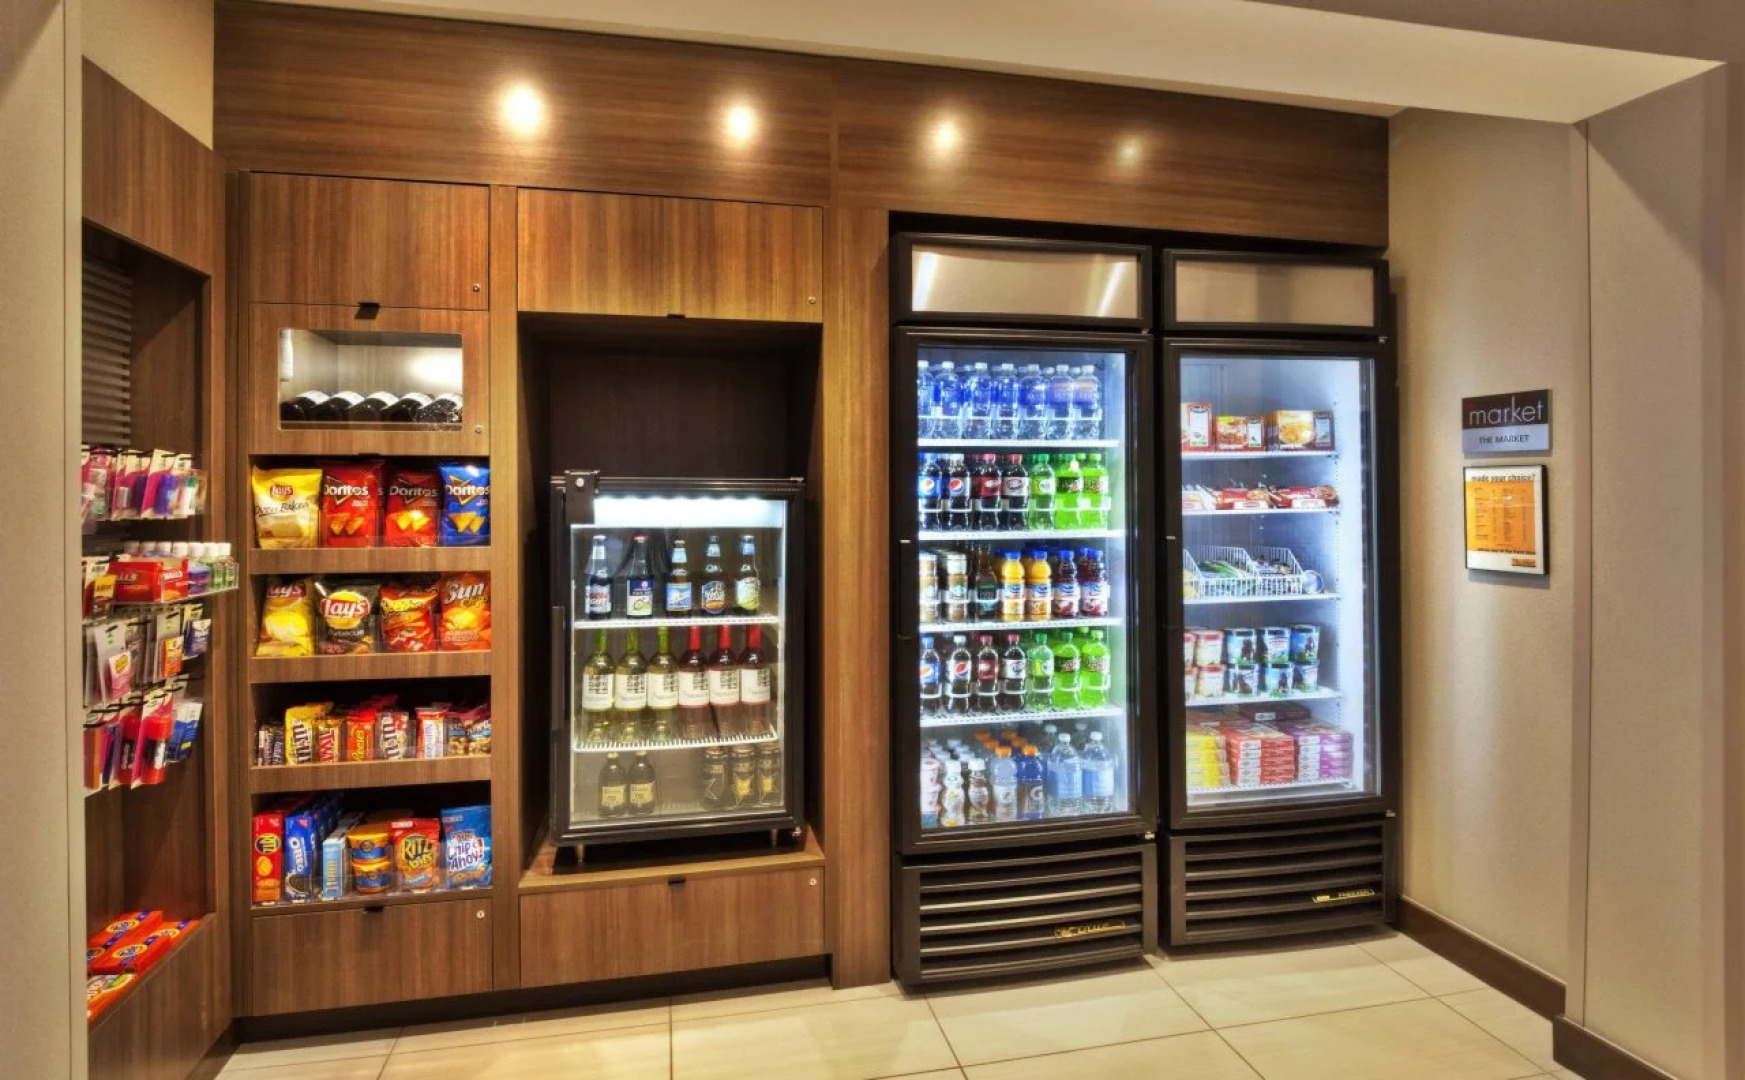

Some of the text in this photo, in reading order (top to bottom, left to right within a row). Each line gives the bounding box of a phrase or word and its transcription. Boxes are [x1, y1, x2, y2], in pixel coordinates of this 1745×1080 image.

[1469, 395, 1543, 425] market
[1478, 434, 1530, 444] THE MARKET
[1491, 475, 1506, 483] your
[1508, 473, 1536, 481] choice?
[324, 484, 369, 496] Doritos
[389, 485, 438, 497] Doritos
[443, 583, 485, 604] Sun
[289, 836, 304, 872] OREO
[404, 836, 433, 862] RITZ
